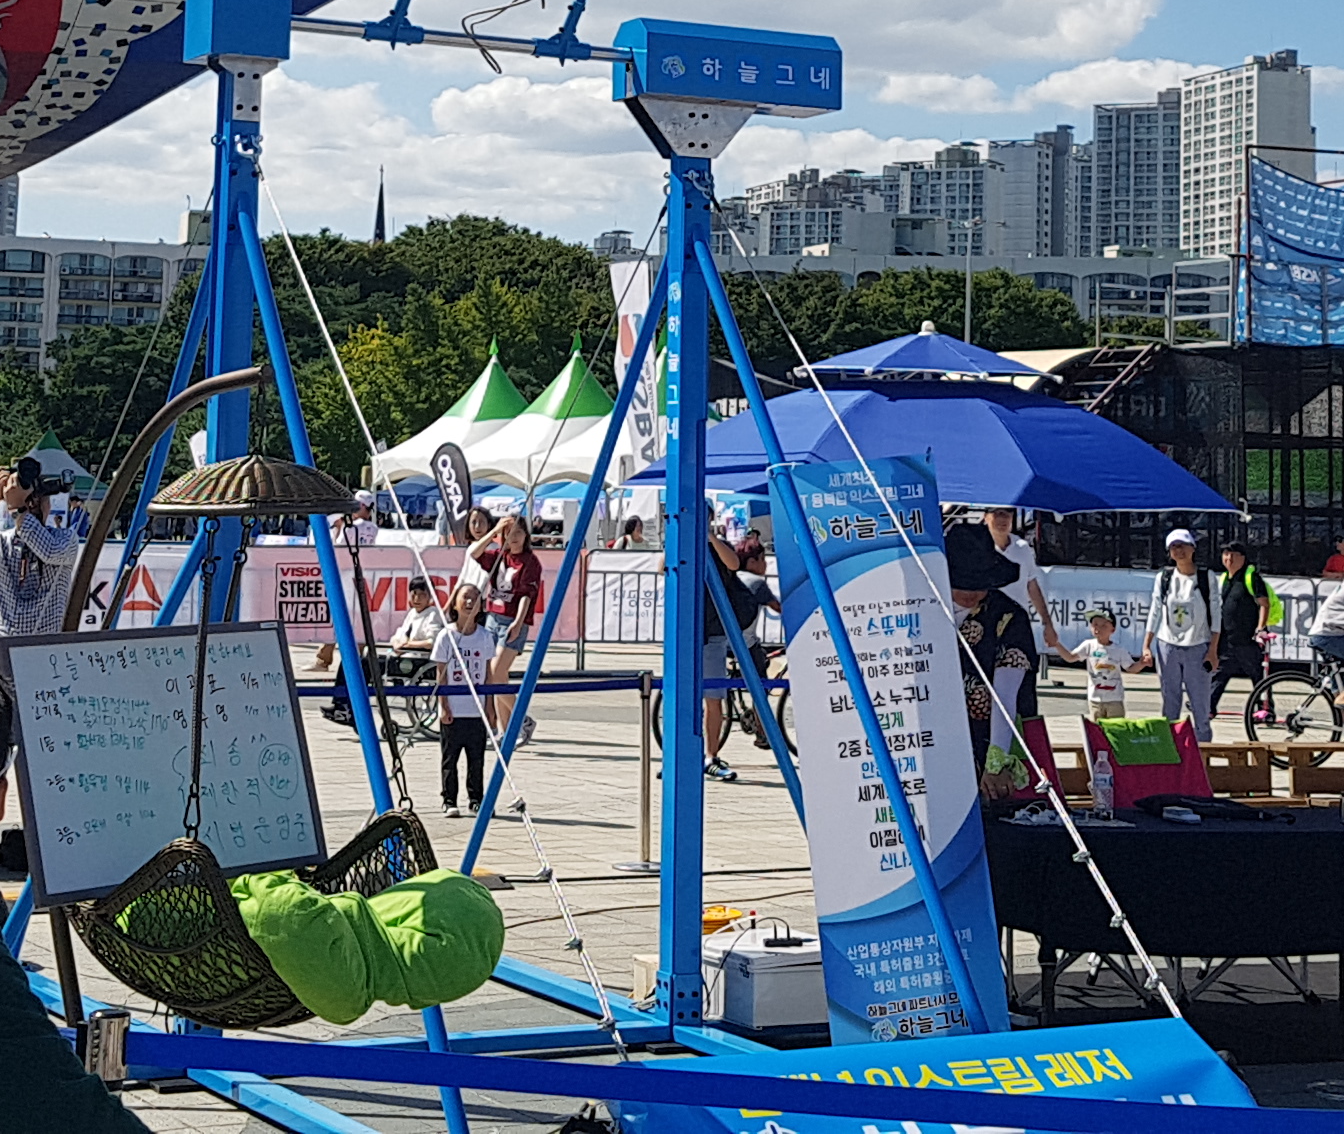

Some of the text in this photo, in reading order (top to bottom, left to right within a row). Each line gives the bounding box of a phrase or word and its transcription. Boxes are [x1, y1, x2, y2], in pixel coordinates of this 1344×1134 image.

[702, 58, 831, 91] 하늘그네
[667, 315, 680, 440] 하늘그네
[900, 483, 925, 500] 그네
[829, 509, 924, 541] 하늘그네
[280, 566, 322, 577] VISIO
[279, 580, 327, 598] STREE
[281, 603, 328, 622] WEAR
[889, 684, 930, 707] 누구나
[837, 739, 862, 759] 2중
[858, 778, 928, 803] 세계초로
[880, 852, 912, 872] 신나
[847, 935, 925, 961] 산업통상자원부
[853, 962, 877, 979] 국내
[880, 955, 924, 974] 특허출원
[873, 978, 897, 995] 해외
[898, 1008, 969, 1036] 하늘그네
[1035, 1048, 1134, 1088] 레저
